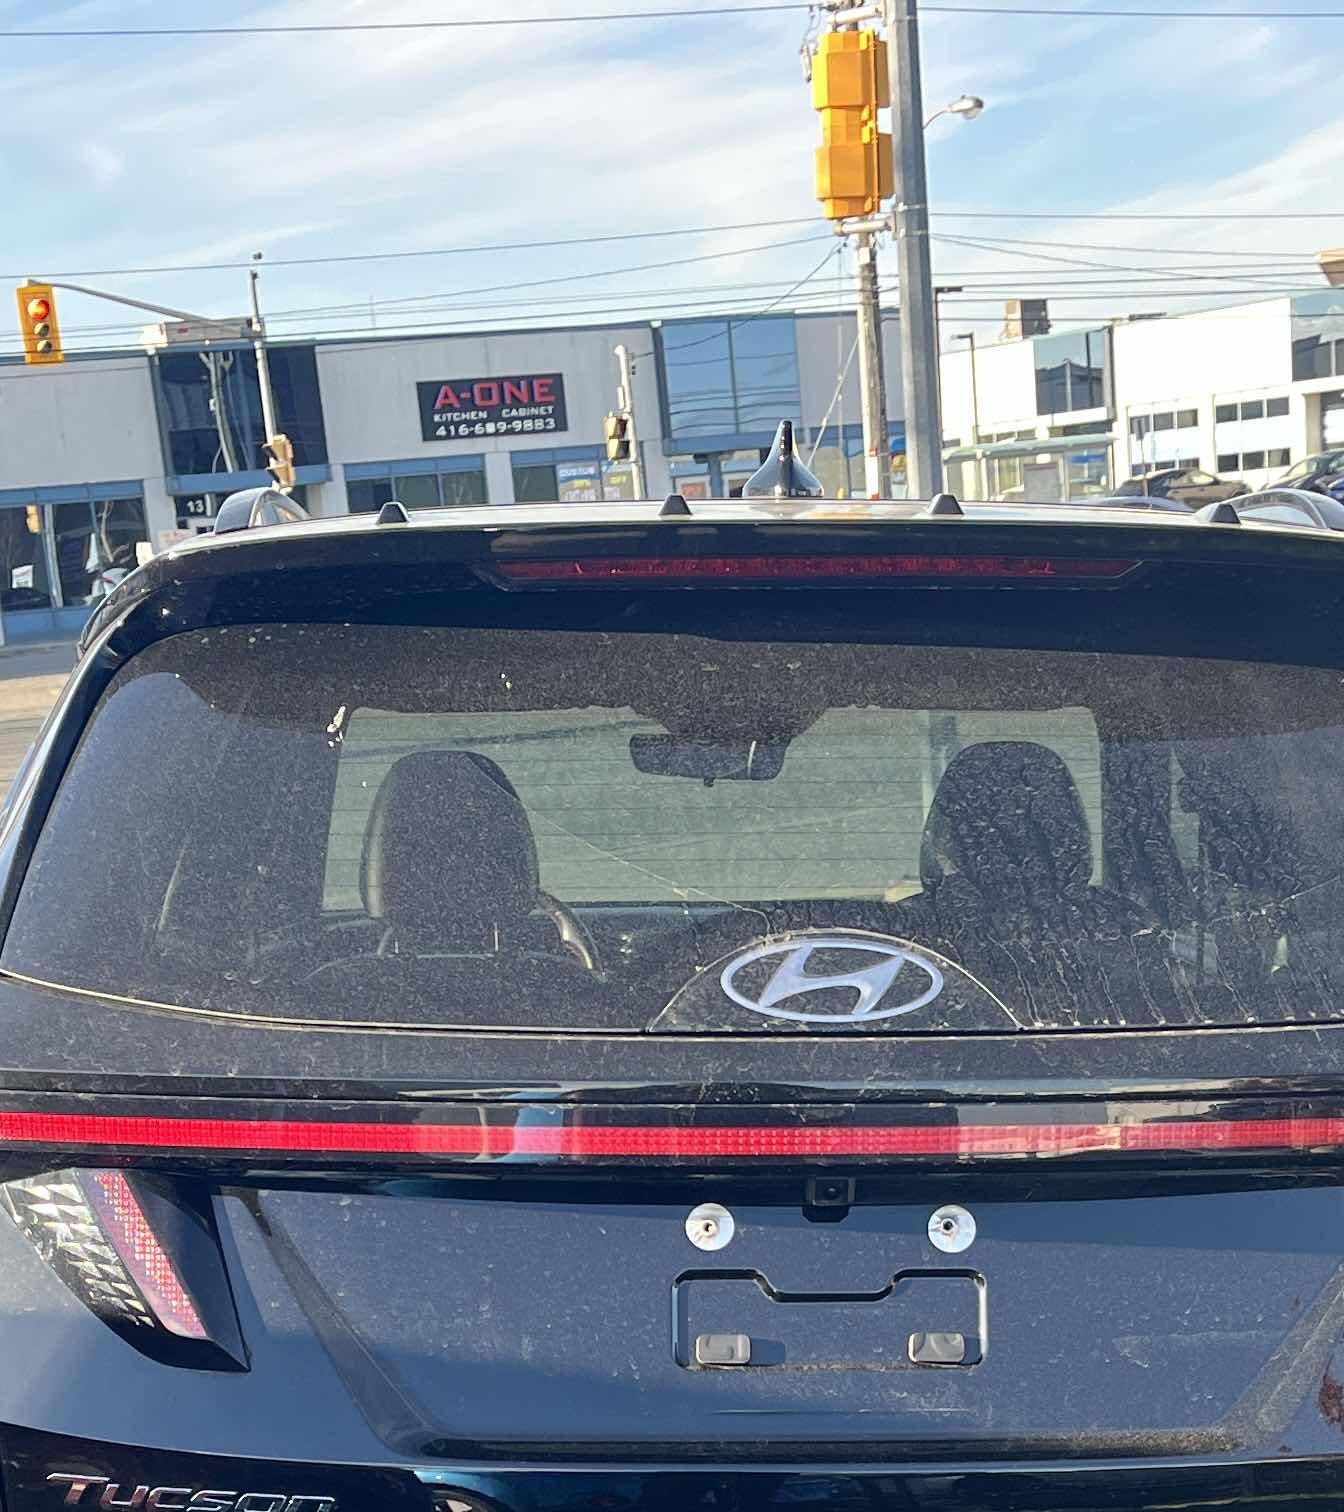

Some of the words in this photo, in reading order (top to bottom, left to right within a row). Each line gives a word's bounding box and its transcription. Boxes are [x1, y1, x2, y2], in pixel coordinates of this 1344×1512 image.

[432, 377, 556, 411] A-ONE
[433, 410, 488, 423] KITCHEN
[501, 405, 554, 418] CABINET
[186, 500, 205, 513] 13
